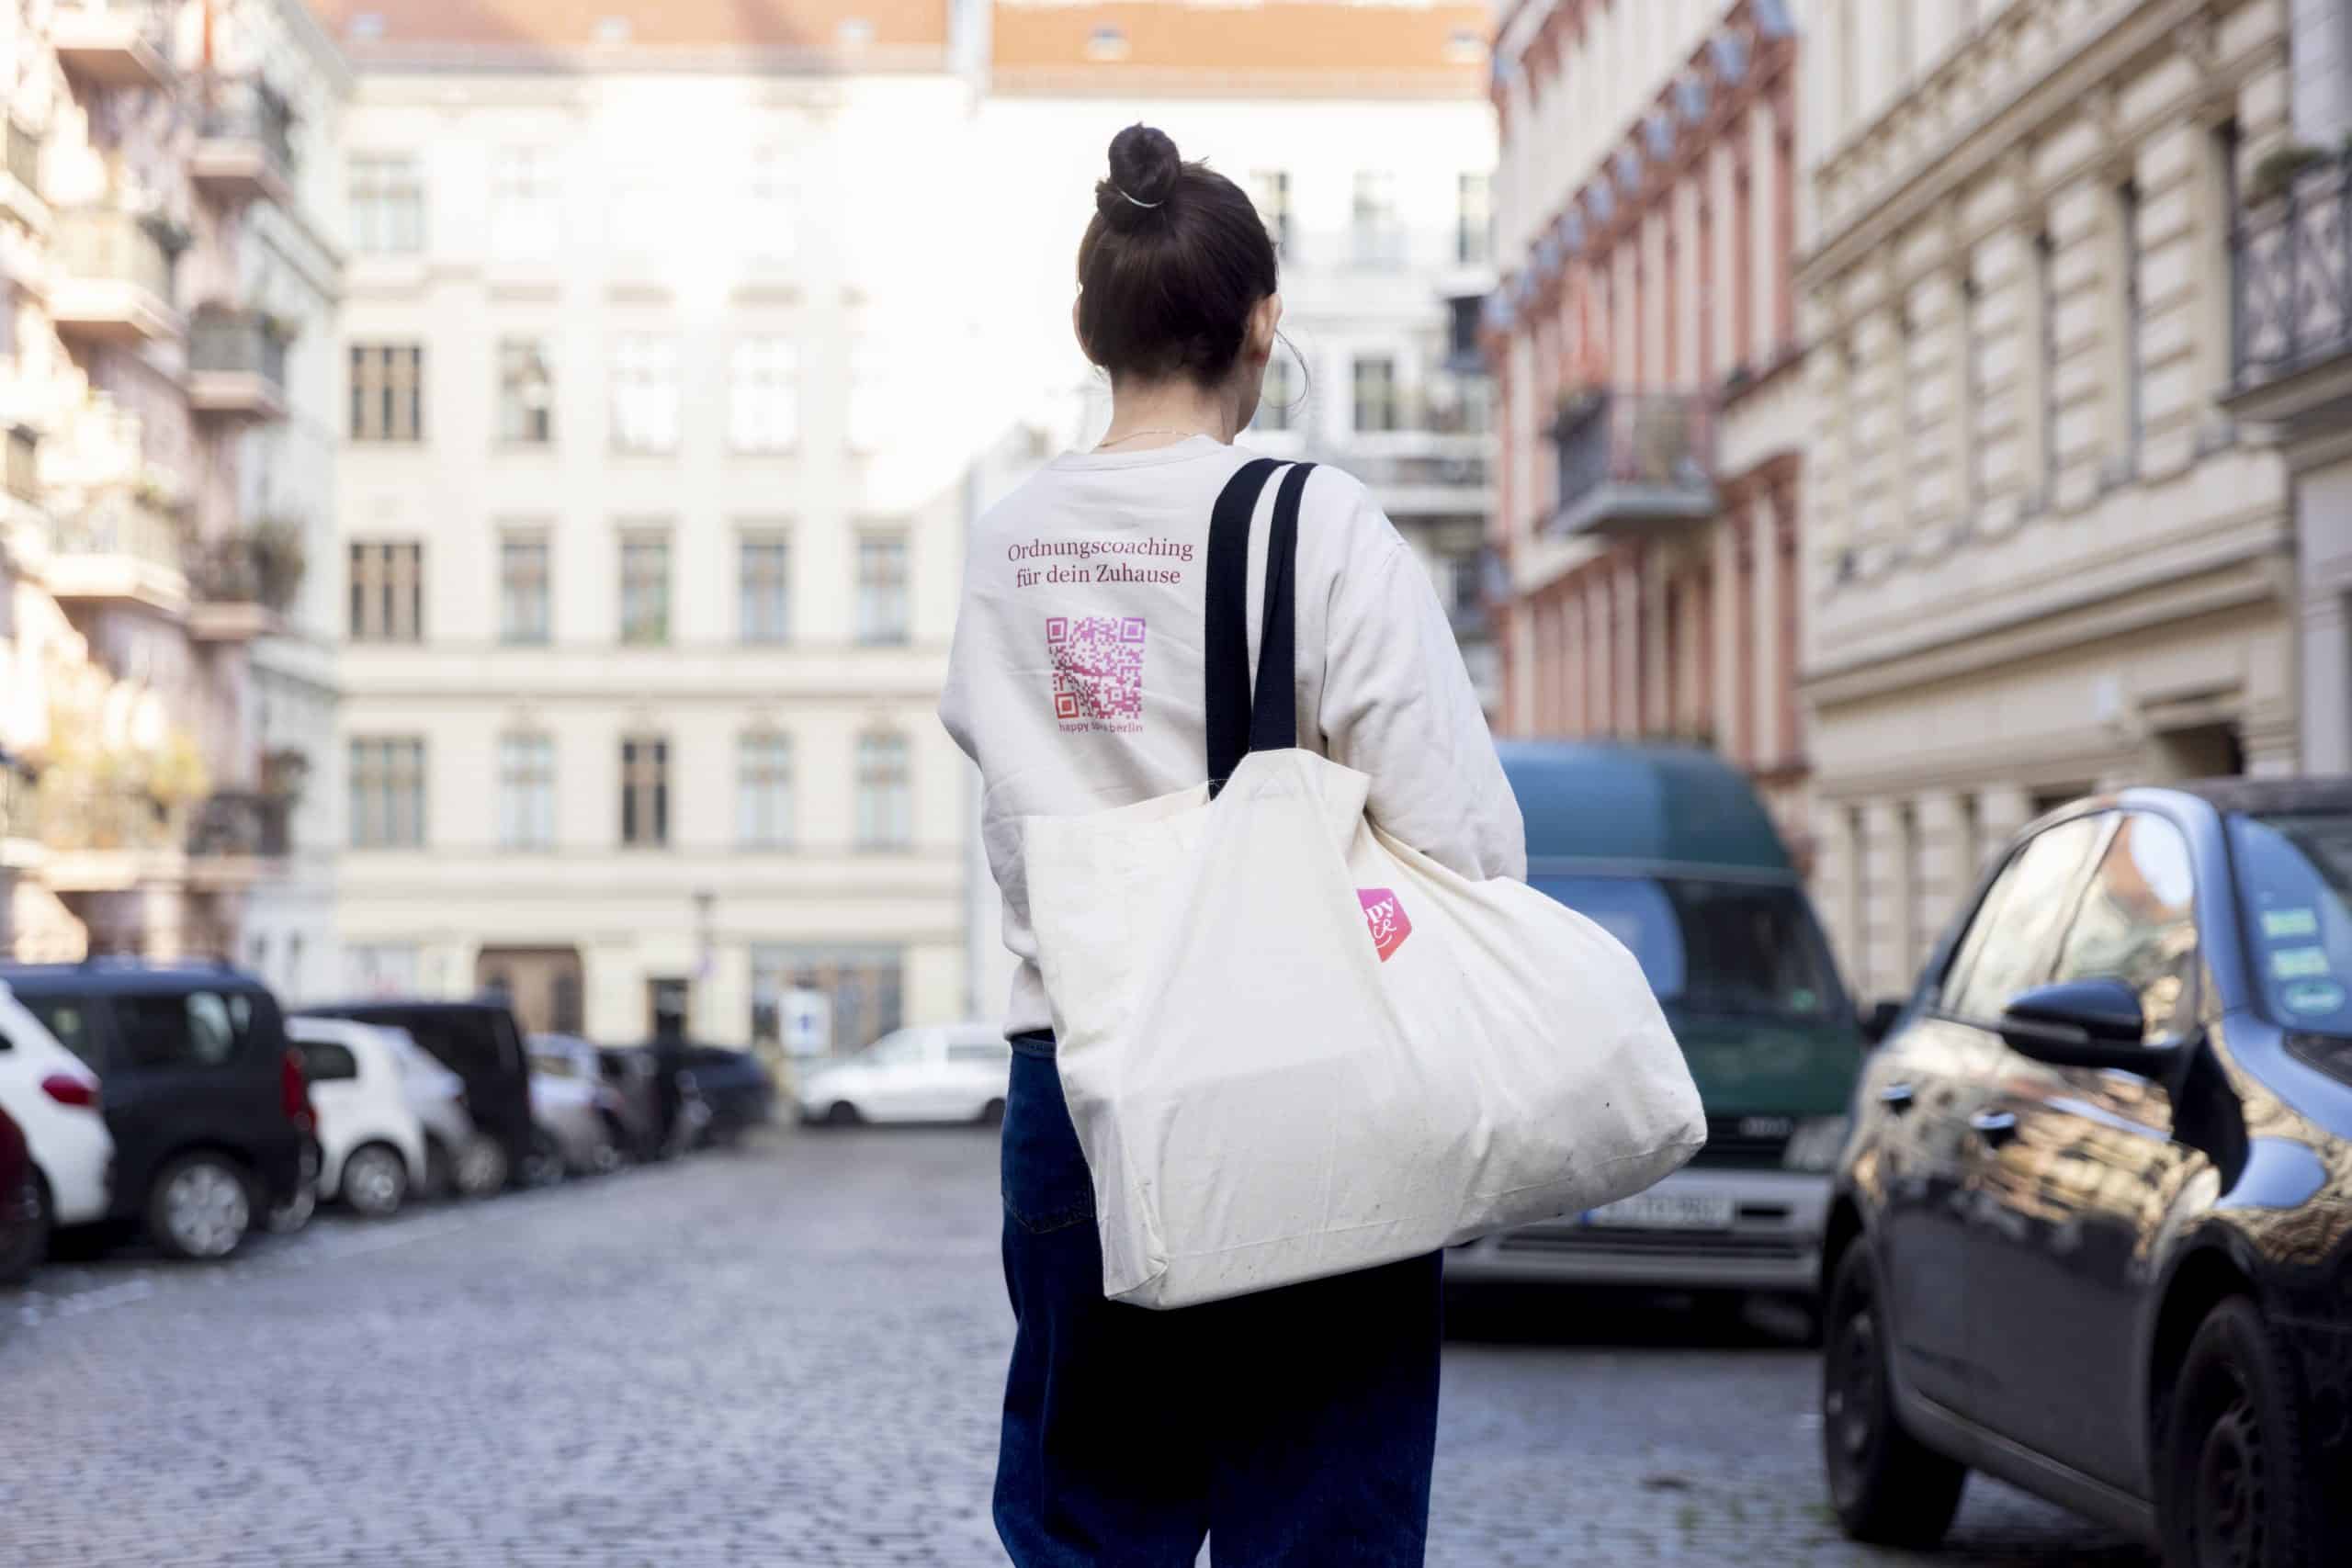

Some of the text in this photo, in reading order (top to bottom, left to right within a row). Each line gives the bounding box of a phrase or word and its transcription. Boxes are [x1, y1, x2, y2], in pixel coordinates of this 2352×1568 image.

[1008, 537, 1193, 562] Ordnungscoaching
[1016, 562, 1182, 588] für dein Zuhause
